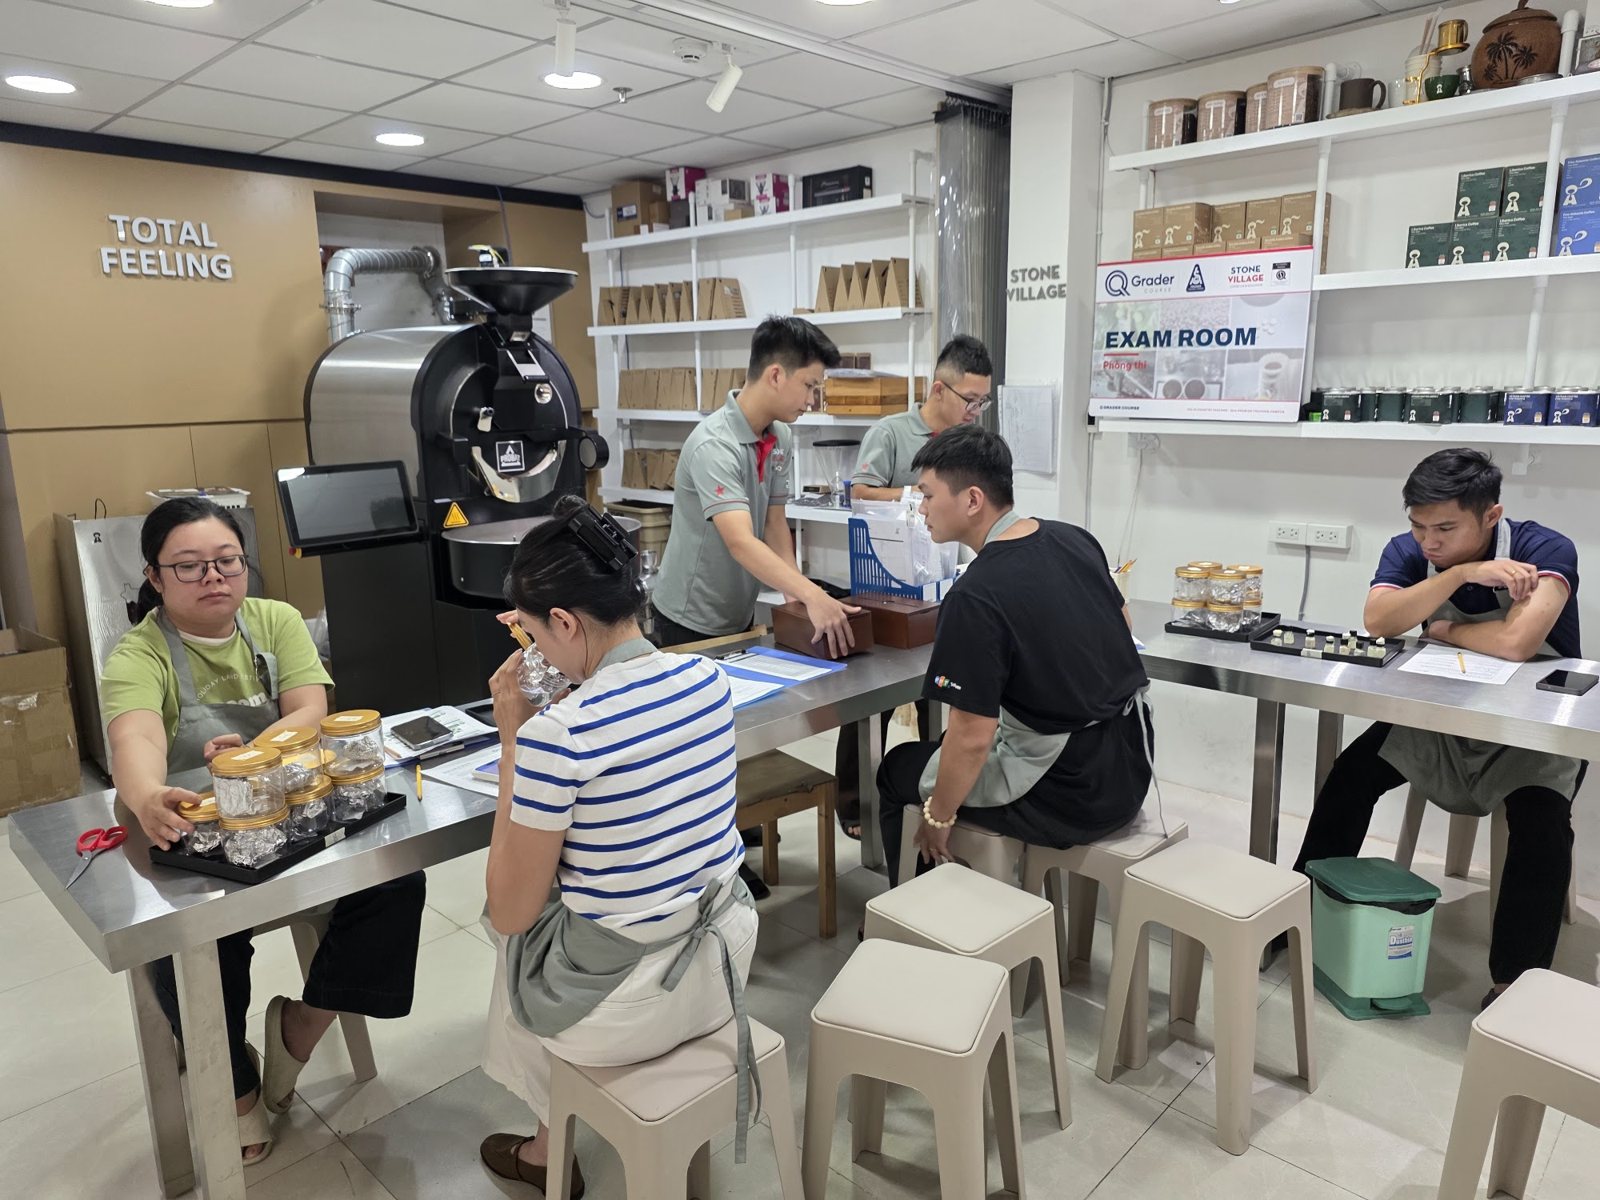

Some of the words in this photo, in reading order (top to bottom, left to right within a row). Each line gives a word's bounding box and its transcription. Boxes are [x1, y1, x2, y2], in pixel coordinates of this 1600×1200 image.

[108, 214, 218, 248] TOTAL
[100, 247, 233, 280] FEELING
[1231, 265, 1261, 275] STONE
[1010, 264, 1060, 284] STONE
[1131, 273, 1175, 287] Grader
[1227, 274, 1264, 284] VILLAGE
[1005, 283, 1067, 302] VILLAGE
[1105, 329, 1172, 349] EXAM
[1178, 327, 1257, 347] ROOM
[196, 677, 219, 702] OLIDAY
